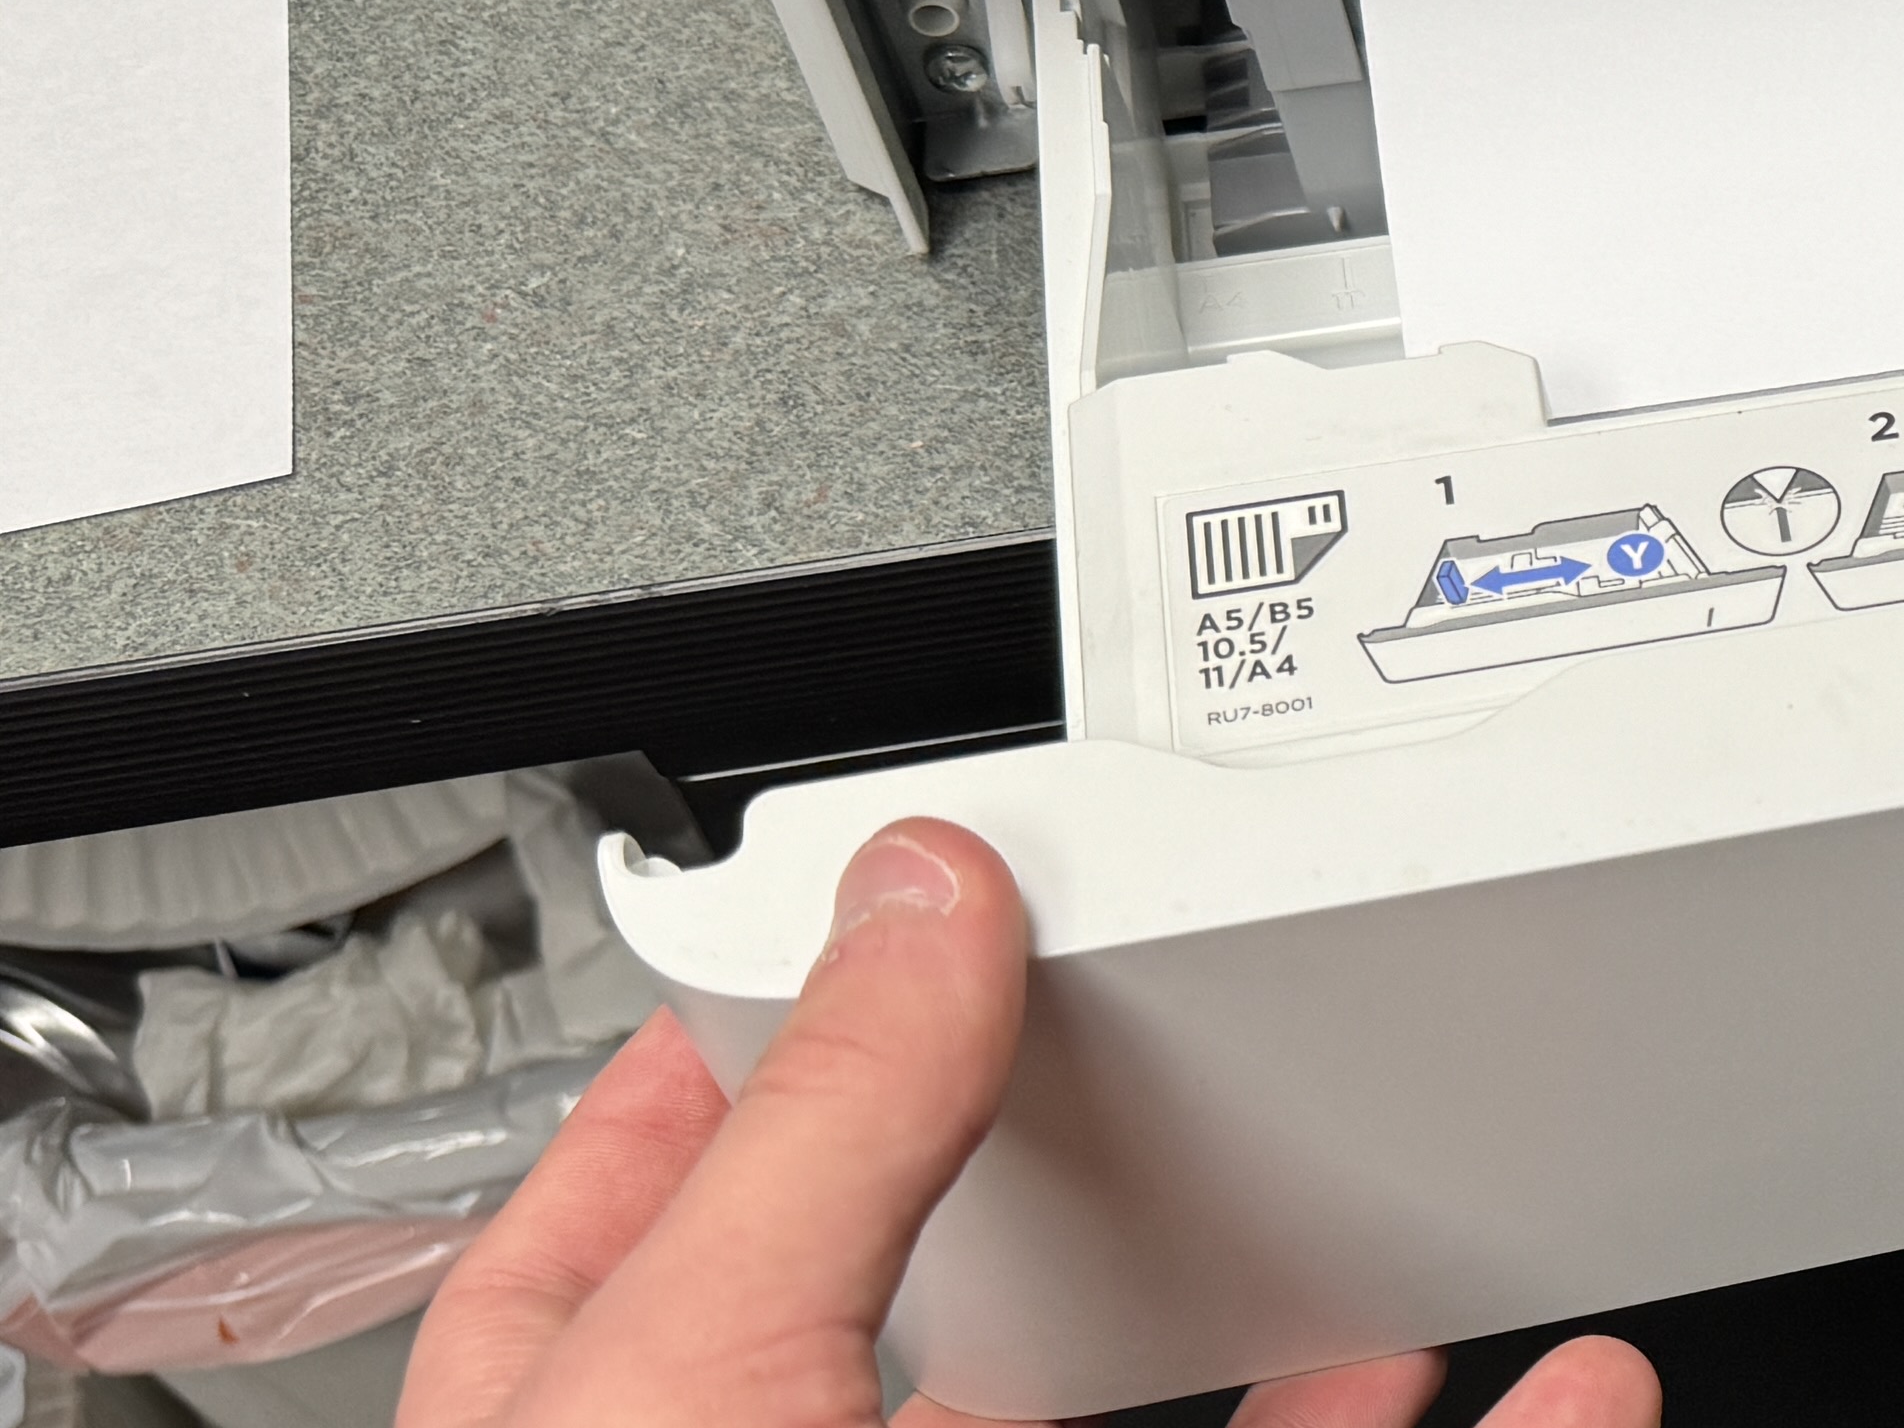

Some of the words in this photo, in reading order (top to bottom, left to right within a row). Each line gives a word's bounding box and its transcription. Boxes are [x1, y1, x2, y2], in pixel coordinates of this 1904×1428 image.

[1869, 411, 1900, 443] 2
[1434, 475, 1455, 506] 1
[1619, 540, 1649, 570] Y
[1196, 597, 1315, 637] A5/B5
[1196, 624, 1288, 663] 10.5/
[1198, 654, 1299, 690] 11/A4
